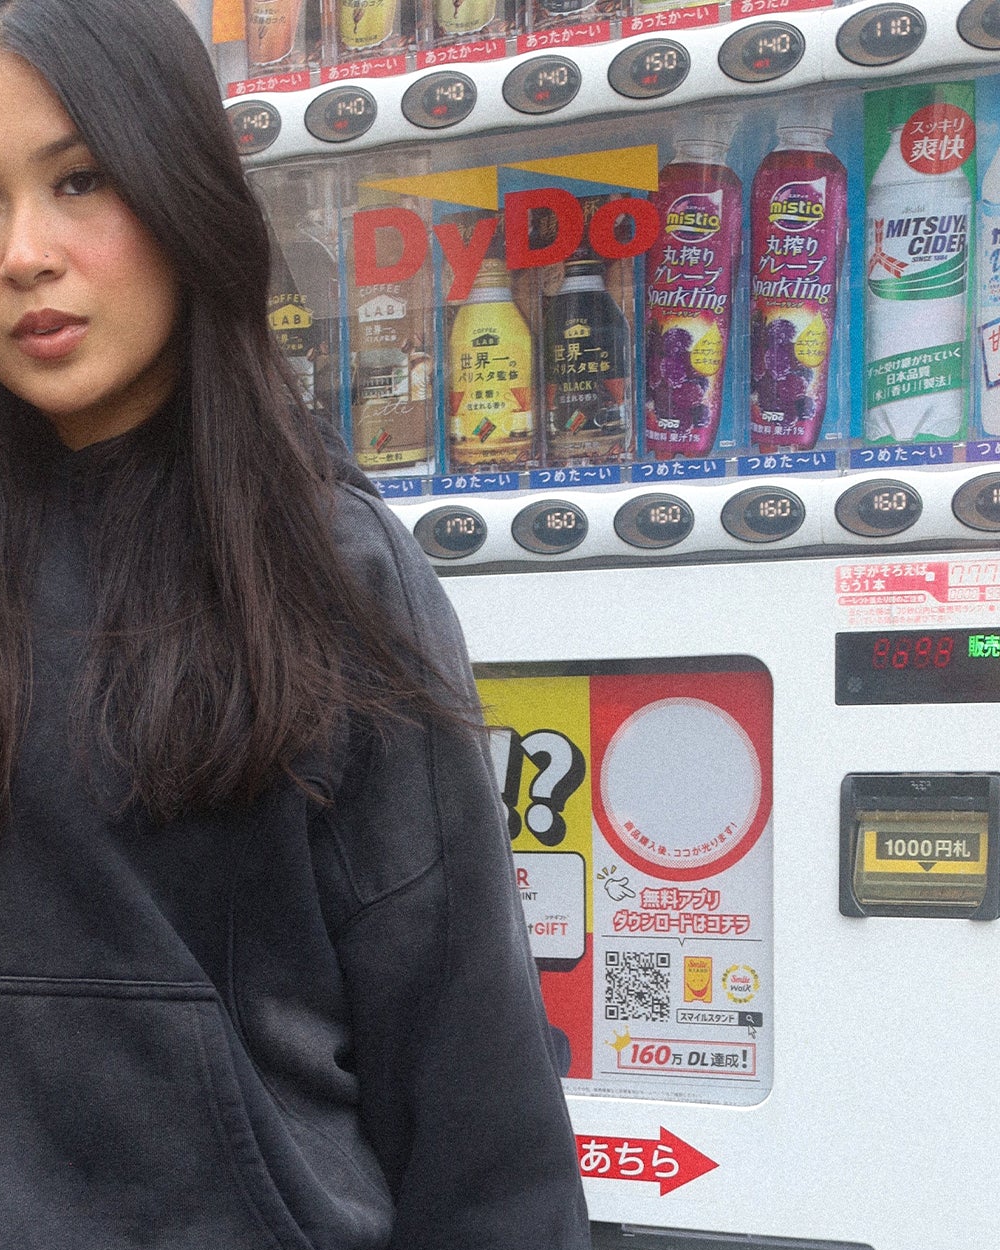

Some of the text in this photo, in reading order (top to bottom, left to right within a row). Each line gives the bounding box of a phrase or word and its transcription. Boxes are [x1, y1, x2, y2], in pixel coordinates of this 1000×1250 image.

[758, 33, 791, 54] 140
[645, 51, 677, 71] 150
[538, 66, 568, 87] 140
[436, 82, 465, 101] 140
[338, 97, 366, 116] 140
[243, 111, 271, 129] 140
[910, 117, 966, 135] スッキリ
[909, 135, 965, 163] 爽快
[770, 200, 824, 216] mistio
[667, 212, 721, 229] mistio
[886, 215, 967, 238] MITSUYA
[353, 187, 661, 301] DyDo
[765, 234, 819, 257] 丸搾り
[908, 234, 967, 256] CIDER
[662, 245, 715, 267] 丸搾り
[758, 255, 828, 276] グレープ
[654, 265, 724, 287] グレープ
[359, 284, 400, 297] COFFEE
[460, 352, 517, 371] 世界一の
[554, 342, 609, 362] 世界一の
[458, 370, 519, 383] バリスタ監修
[552, 361, 611, 375] バリスタ監修
[886, 366, 931, 386] 日本品質
[658, 421, 681, 430] DyDo
[762, 414, 785, 423] DyDo
[669, 433, 701, 443] 果汁1%
[774, 426, 805, 436] 果汁1%
[759, 499, 791, 517] 160
[873, 492, 907, 511] 160
[547, 511, 576, 529] 160
[650, 505, 682, 524] 160
[840, 564, 928, 580] 数字がそろえば
[840, 579, 886, 592] もう1本
[968, 634, 1000, 658] 販売
[884, 837, 971, 858] 1000円札
[640, 887, 721, 911] 無料アプリ
[613, 909, 751, 935] ダウンロードはコチラ
[680, 1012, 735, 1023] スマイルスタンド
[580, 1139, 680, 1178] あちら
